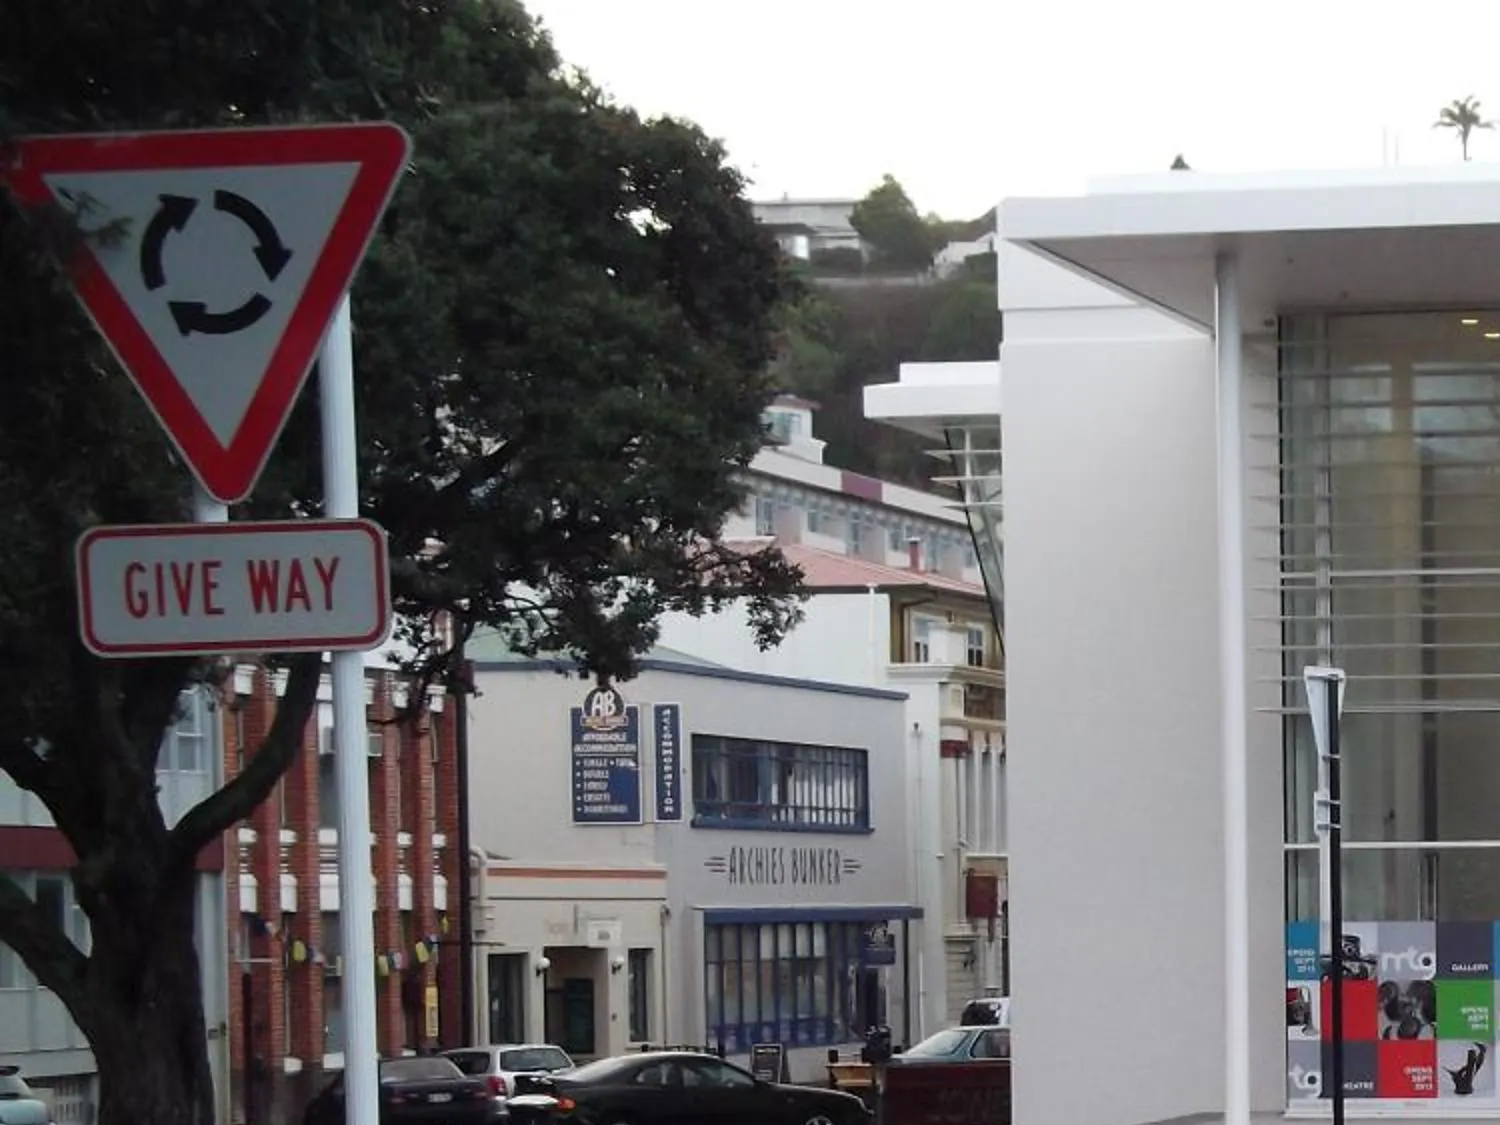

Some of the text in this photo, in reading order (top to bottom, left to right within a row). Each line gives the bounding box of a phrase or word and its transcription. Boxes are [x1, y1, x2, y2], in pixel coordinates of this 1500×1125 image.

[125, 556, 340, 619] GIVE WAY
[592, 690, 616, 716] AB
[729, 847, 841, 885] ARCHIES BUNKER
[1380, 945, 1437, 981] mtg
[1451, 963, 1489, 971] GALLERY
[1343, 1082, 1374, 1090] HEATRE
